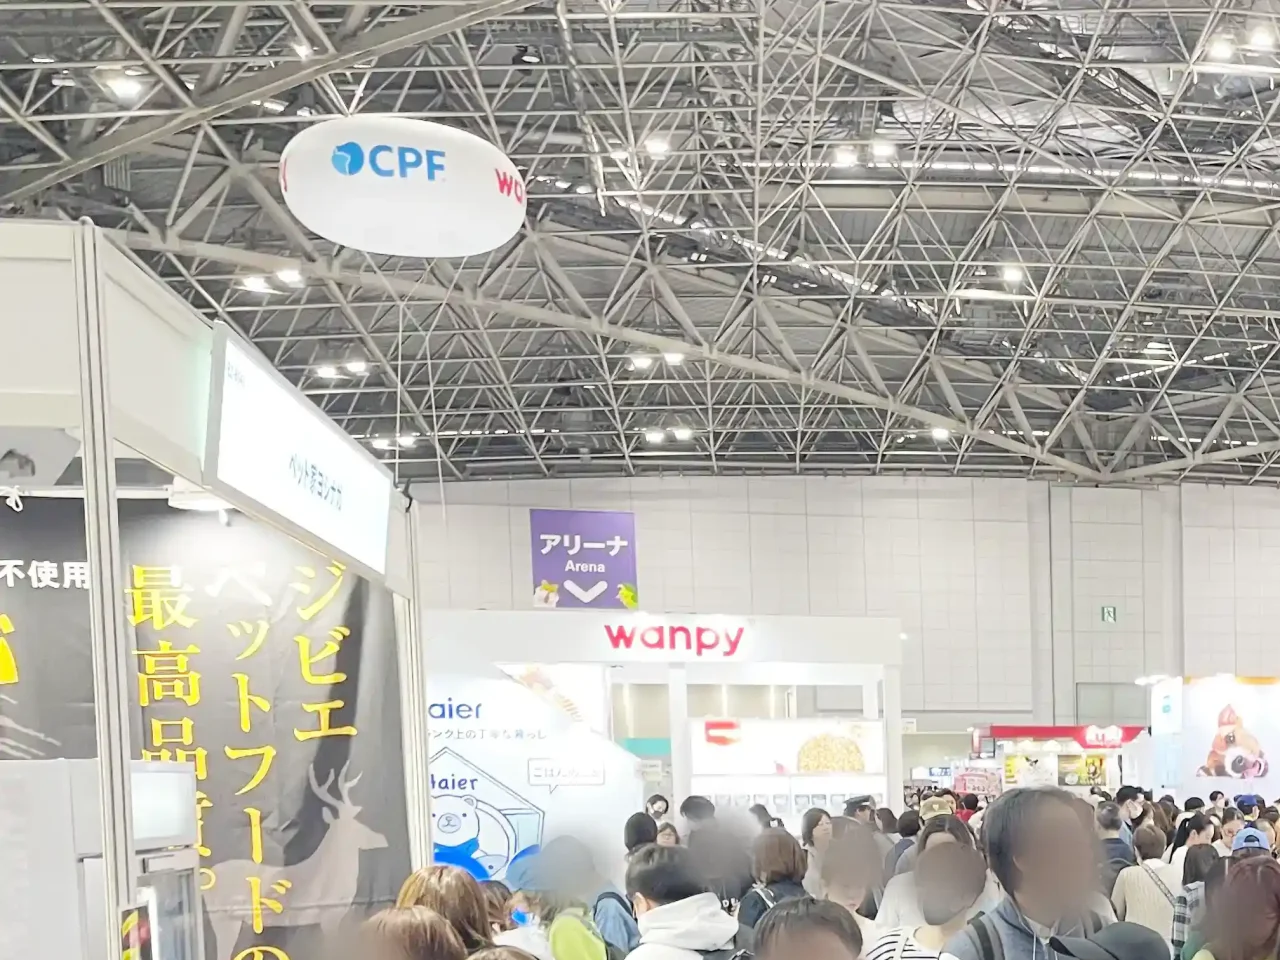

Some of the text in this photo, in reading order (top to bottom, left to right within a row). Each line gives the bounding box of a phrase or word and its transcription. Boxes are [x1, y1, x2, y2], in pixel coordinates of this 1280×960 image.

[368, 144, 446, 181] CPF
[539, 534, 629, 556] アリーナ
[564, 559, 606, 573] Arena
[289, 560, 358, 741] ジビエ
[604, 624, 745, 657] wanpy
[428, 697, 482, 719] aier
[124, 563, 217, 890] 最高品。
